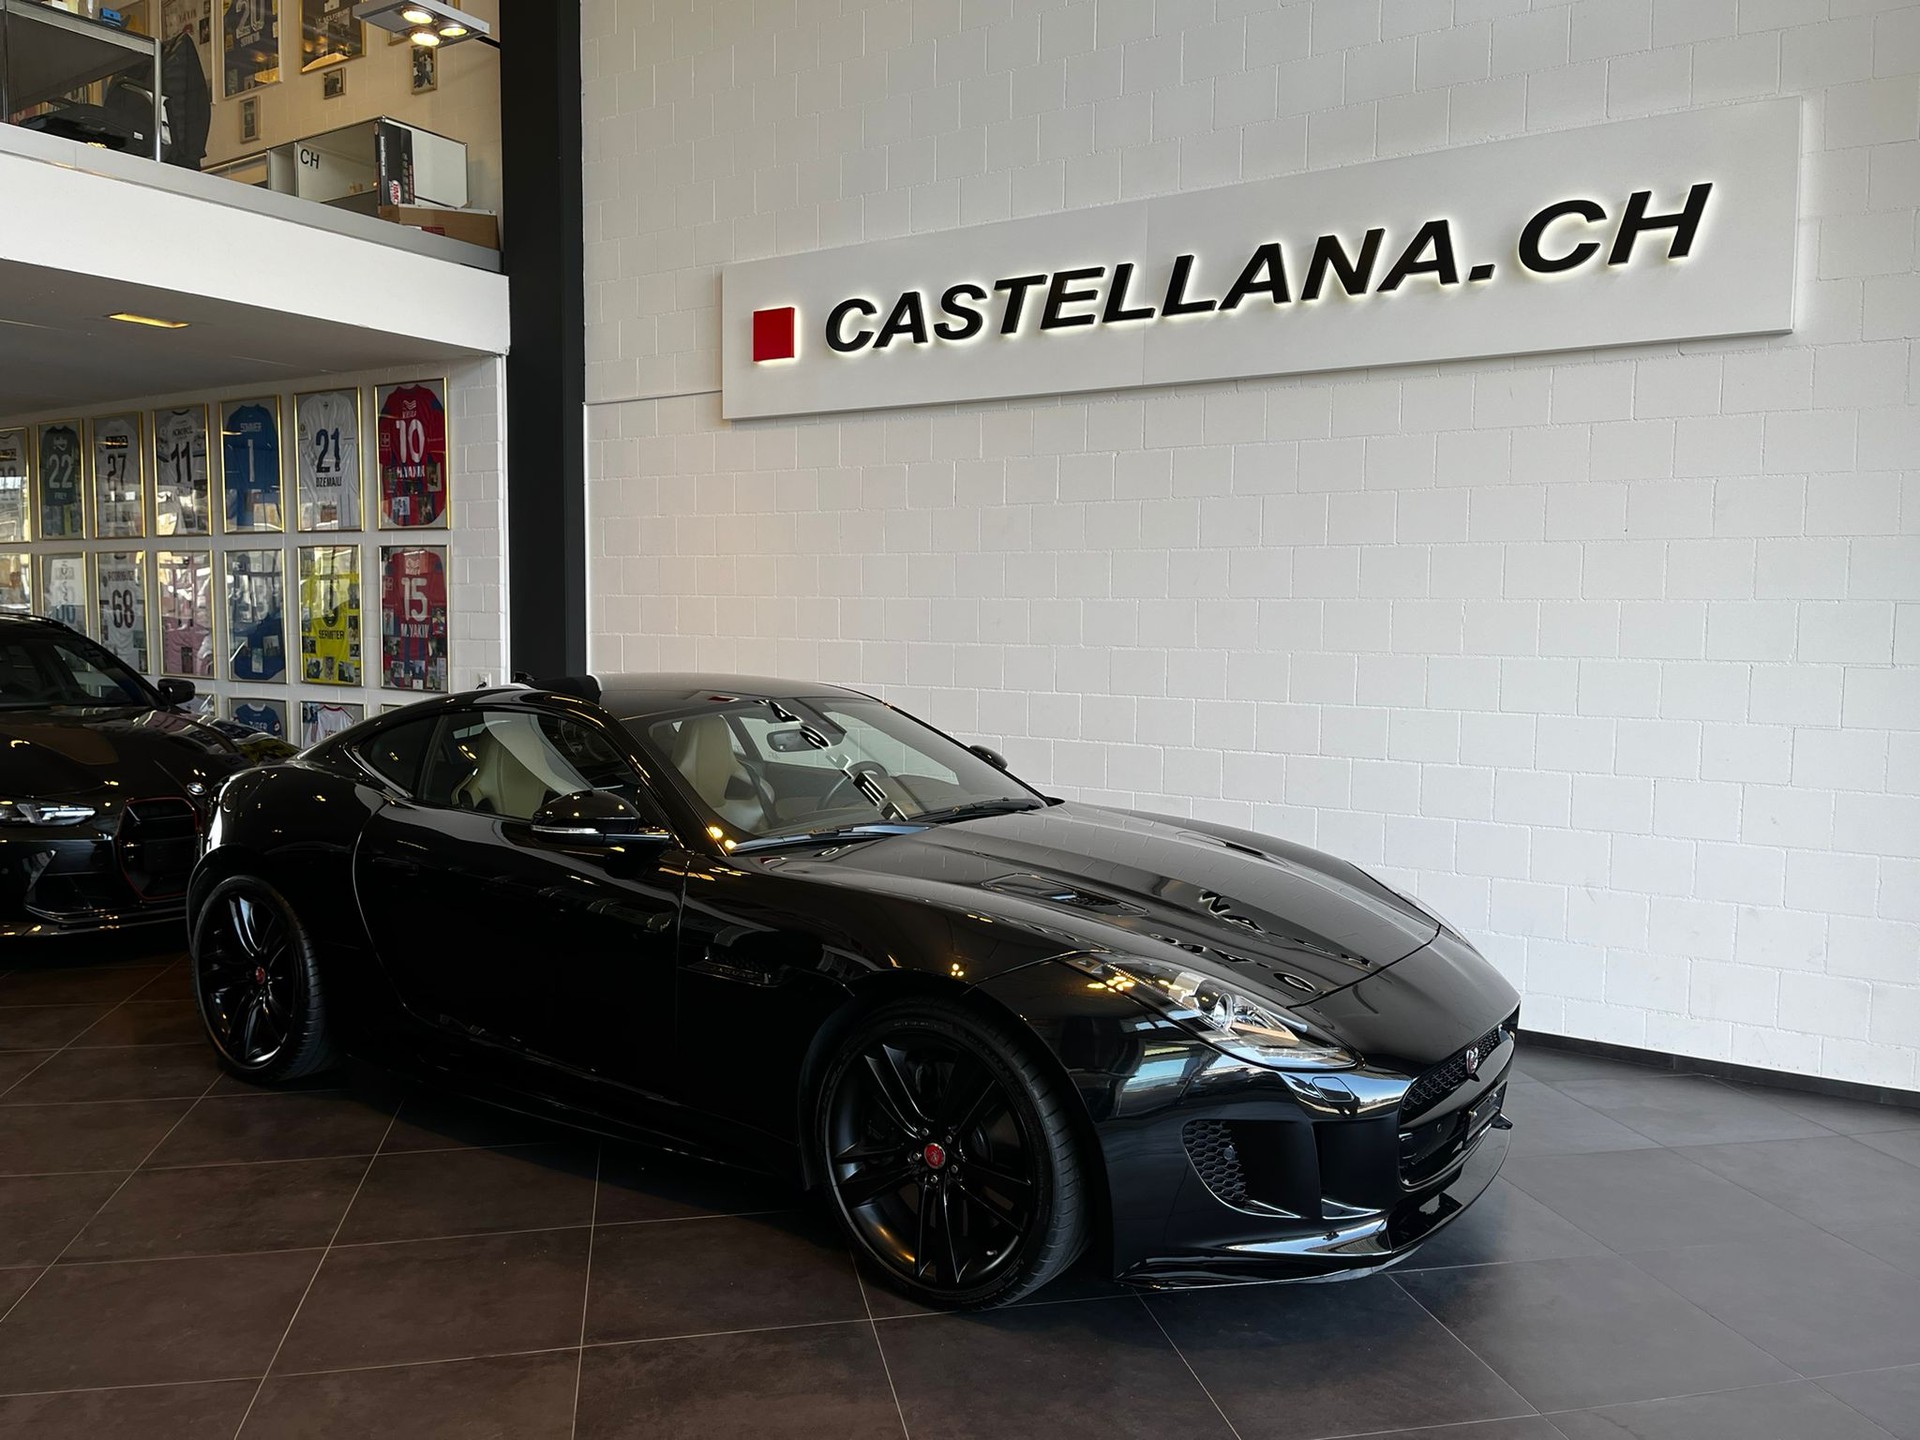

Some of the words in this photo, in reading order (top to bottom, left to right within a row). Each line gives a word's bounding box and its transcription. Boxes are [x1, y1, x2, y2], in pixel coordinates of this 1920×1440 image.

[300, 148, 320, 169] CH
[824, 182, 1714, 354] CASTELLANA.CH
[170, 441, 191, 483] 11
[315, 427, 341, 473] 21
[395, 418, 425, 464] 10
[49, 453, 73, 489] 22
[112, 589, 135, 628] 68
[400, 577, 427, 622] 15
